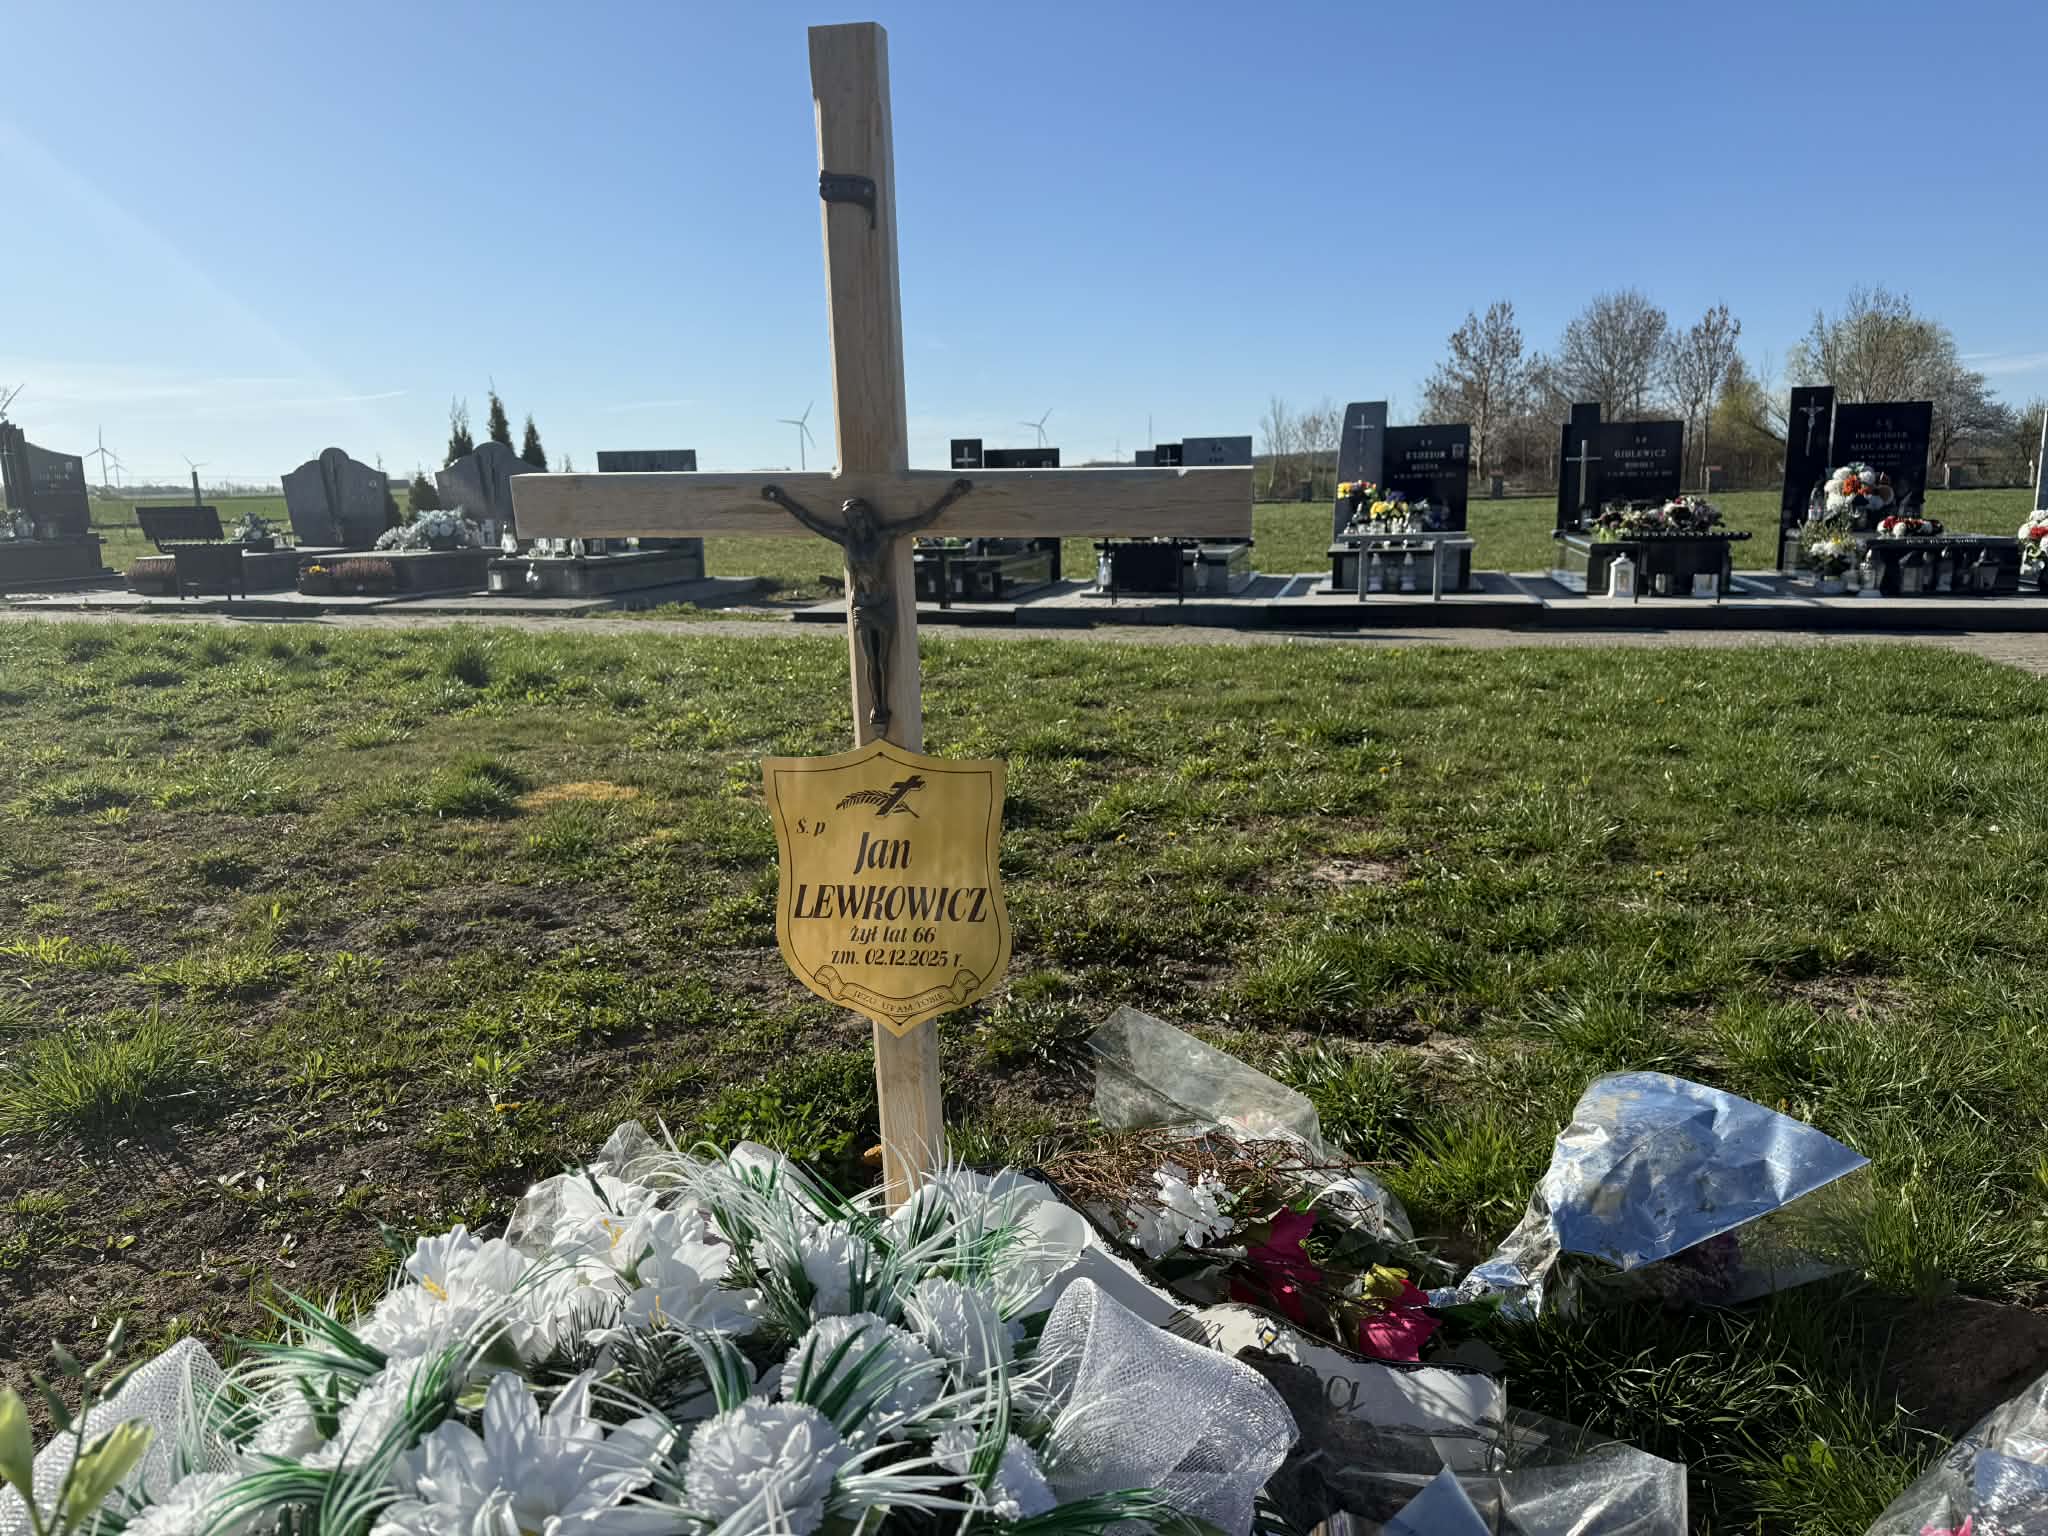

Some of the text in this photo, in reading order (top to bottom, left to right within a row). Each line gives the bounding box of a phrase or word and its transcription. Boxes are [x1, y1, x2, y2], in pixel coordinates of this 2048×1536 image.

[853, 831, 912, 875] Jan
[793, 884, 988, 923] LEWKOWICZ
[883, 925, 907, 943] lat
[912, 926, 937, 943] 66
[831, 948, 964, 968] zm. 02.12.2025 r.
